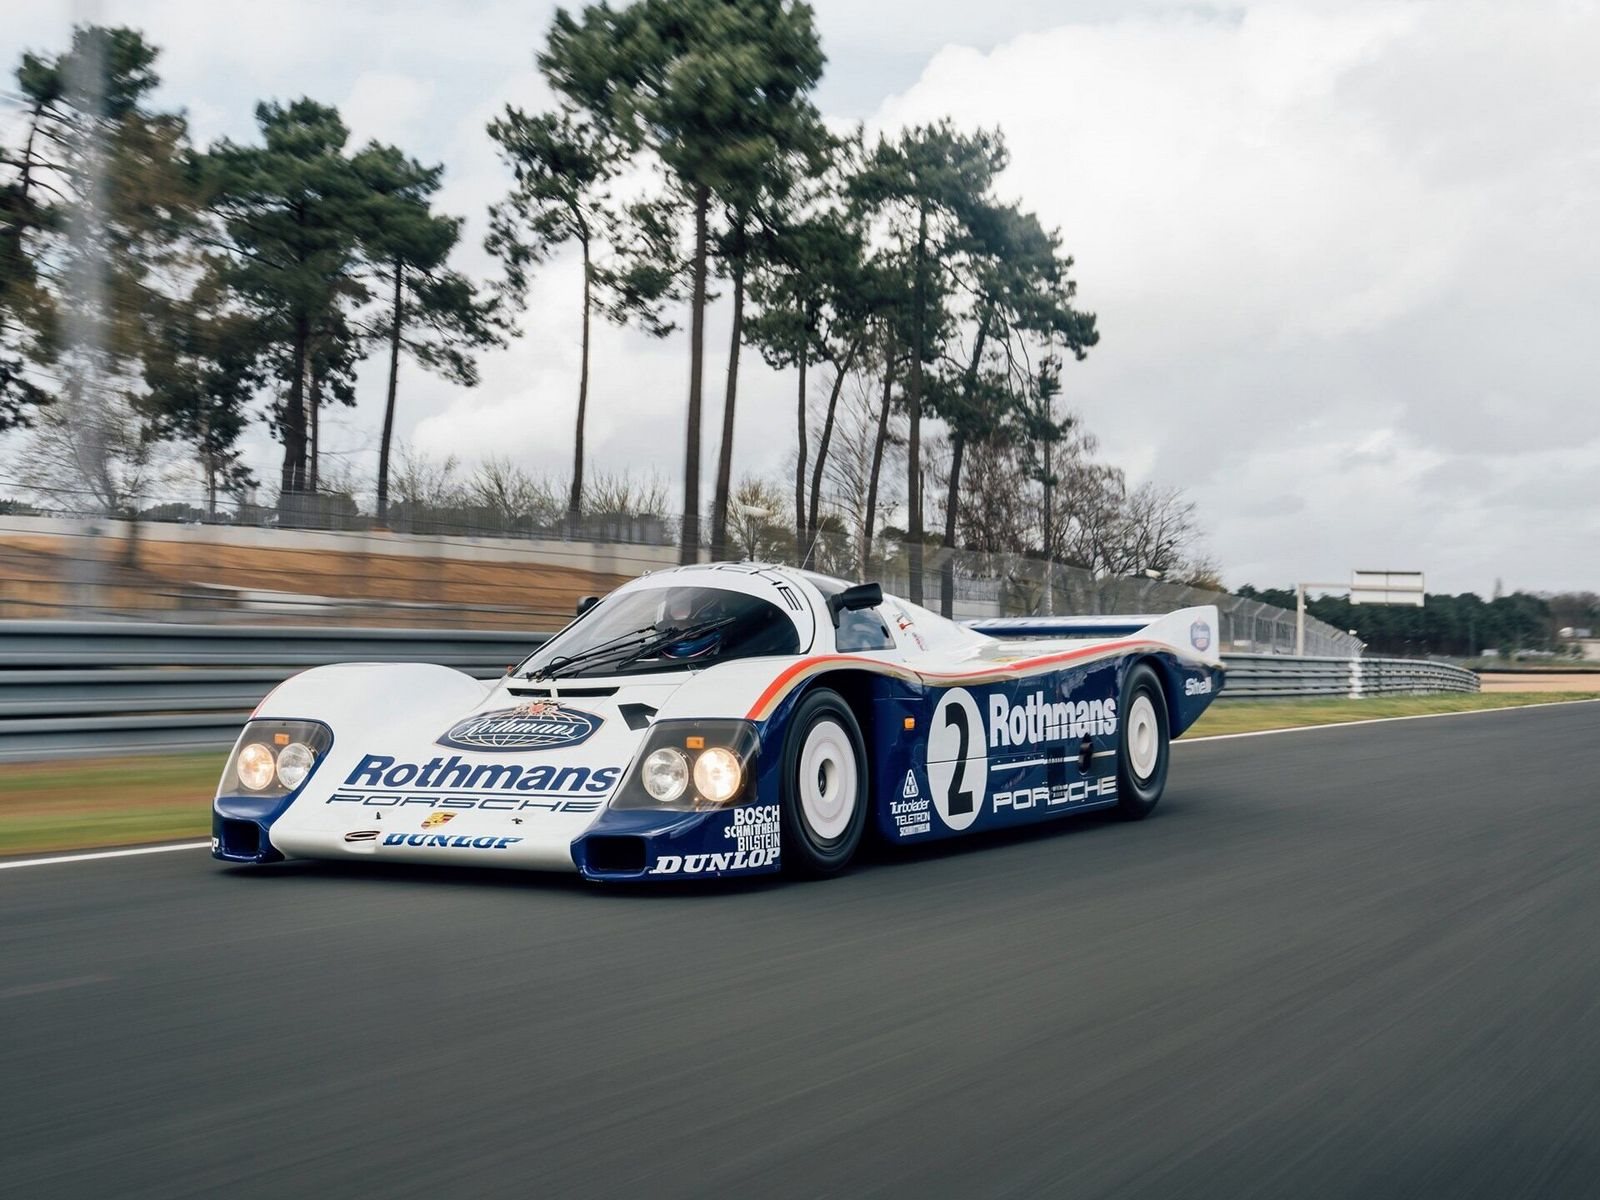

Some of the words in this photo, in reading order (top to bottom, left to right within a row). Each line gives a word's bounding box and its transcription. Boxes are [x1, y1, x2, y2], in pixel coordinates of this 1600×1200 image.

[456, 718, 578, 739] Rothmans
[989, 690, 1117, 747] Rothmans
[945, 702, 973, 816] 2
[344, 753, 622, 792] Rothmans
[325, 793, 603, 812] PORSCHE
[993, 775, 1118, 813] PORSCHE
[734, 805, 780, 826] BOSCH
[724, 821, 780, 838] SCHMITTHELM
[383, 832, 525, 849] DUNLOP
[738, 832, 780, 851] BILSTEIN
[648, 847, 781, 874] DUNLOP
